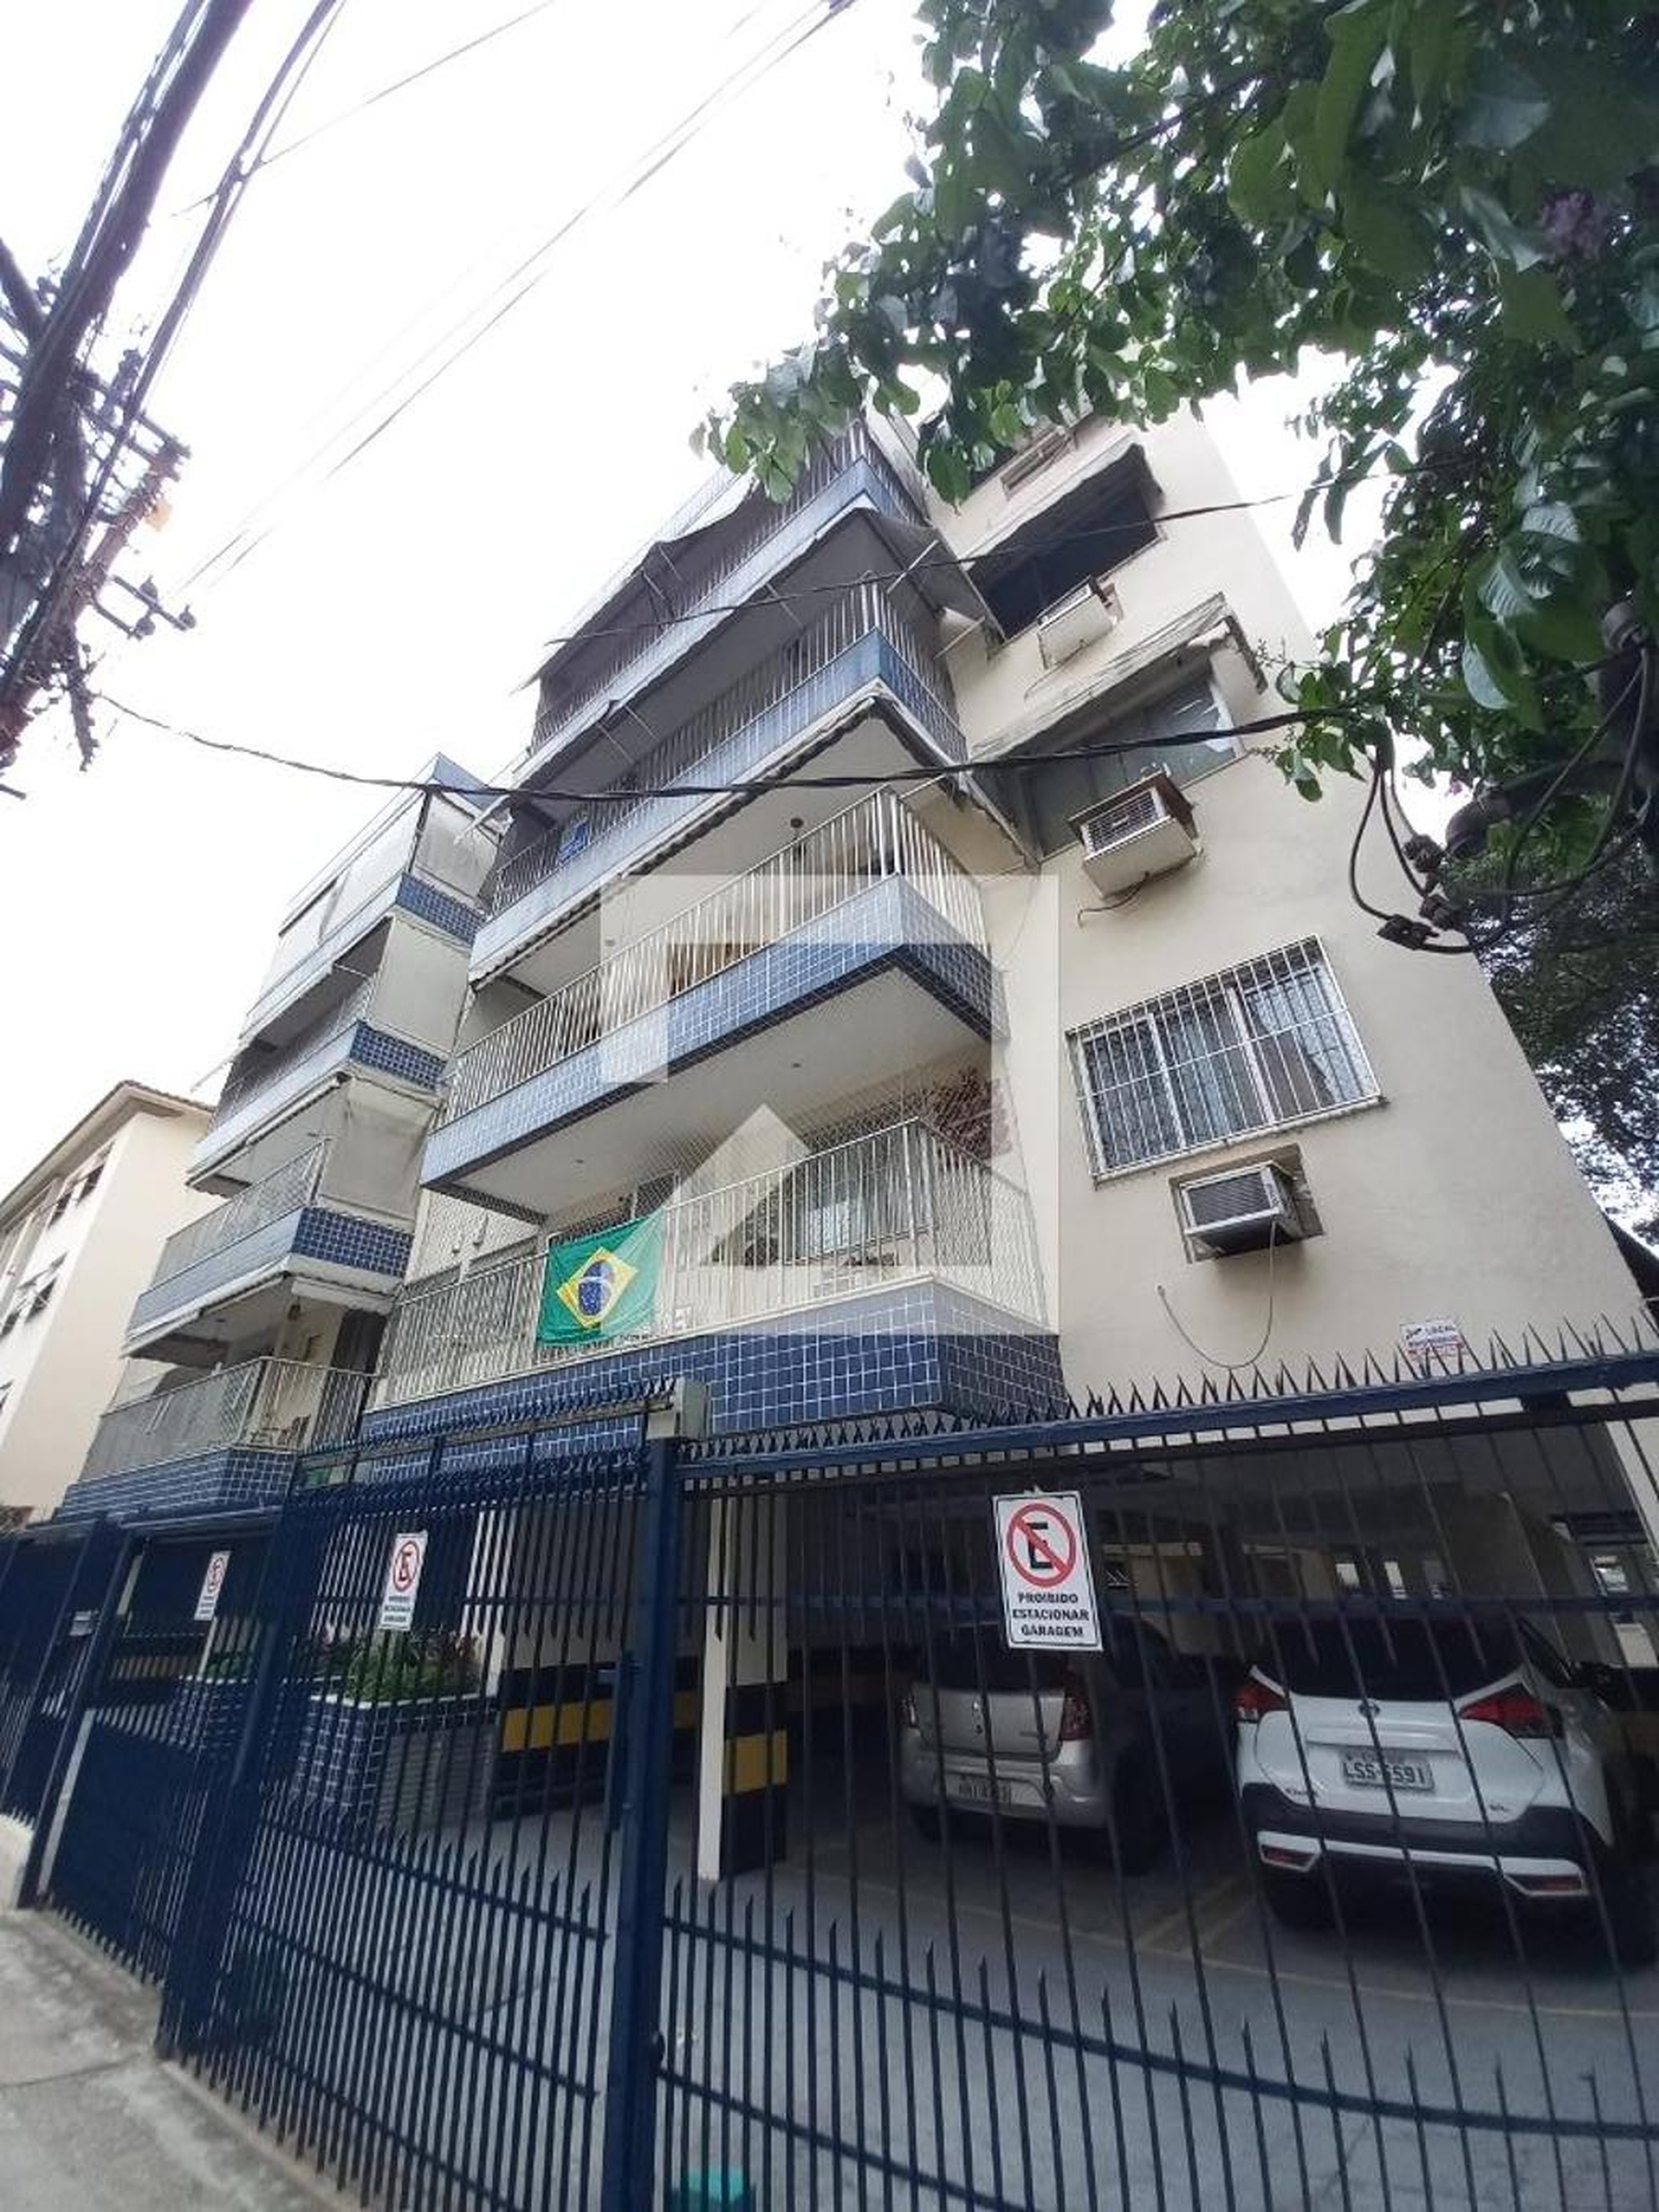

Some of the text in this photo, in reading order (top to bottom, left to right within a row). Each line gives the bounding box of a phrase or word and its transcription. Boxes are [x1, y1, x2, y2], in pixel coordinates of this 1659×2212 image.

[1017, 1592, 1078, 1604] PROIBIDO
[1012, 1609, 1090, 1621] ESTACIONAR
[1021, 1624, 1084, 1637] GARAGEM
